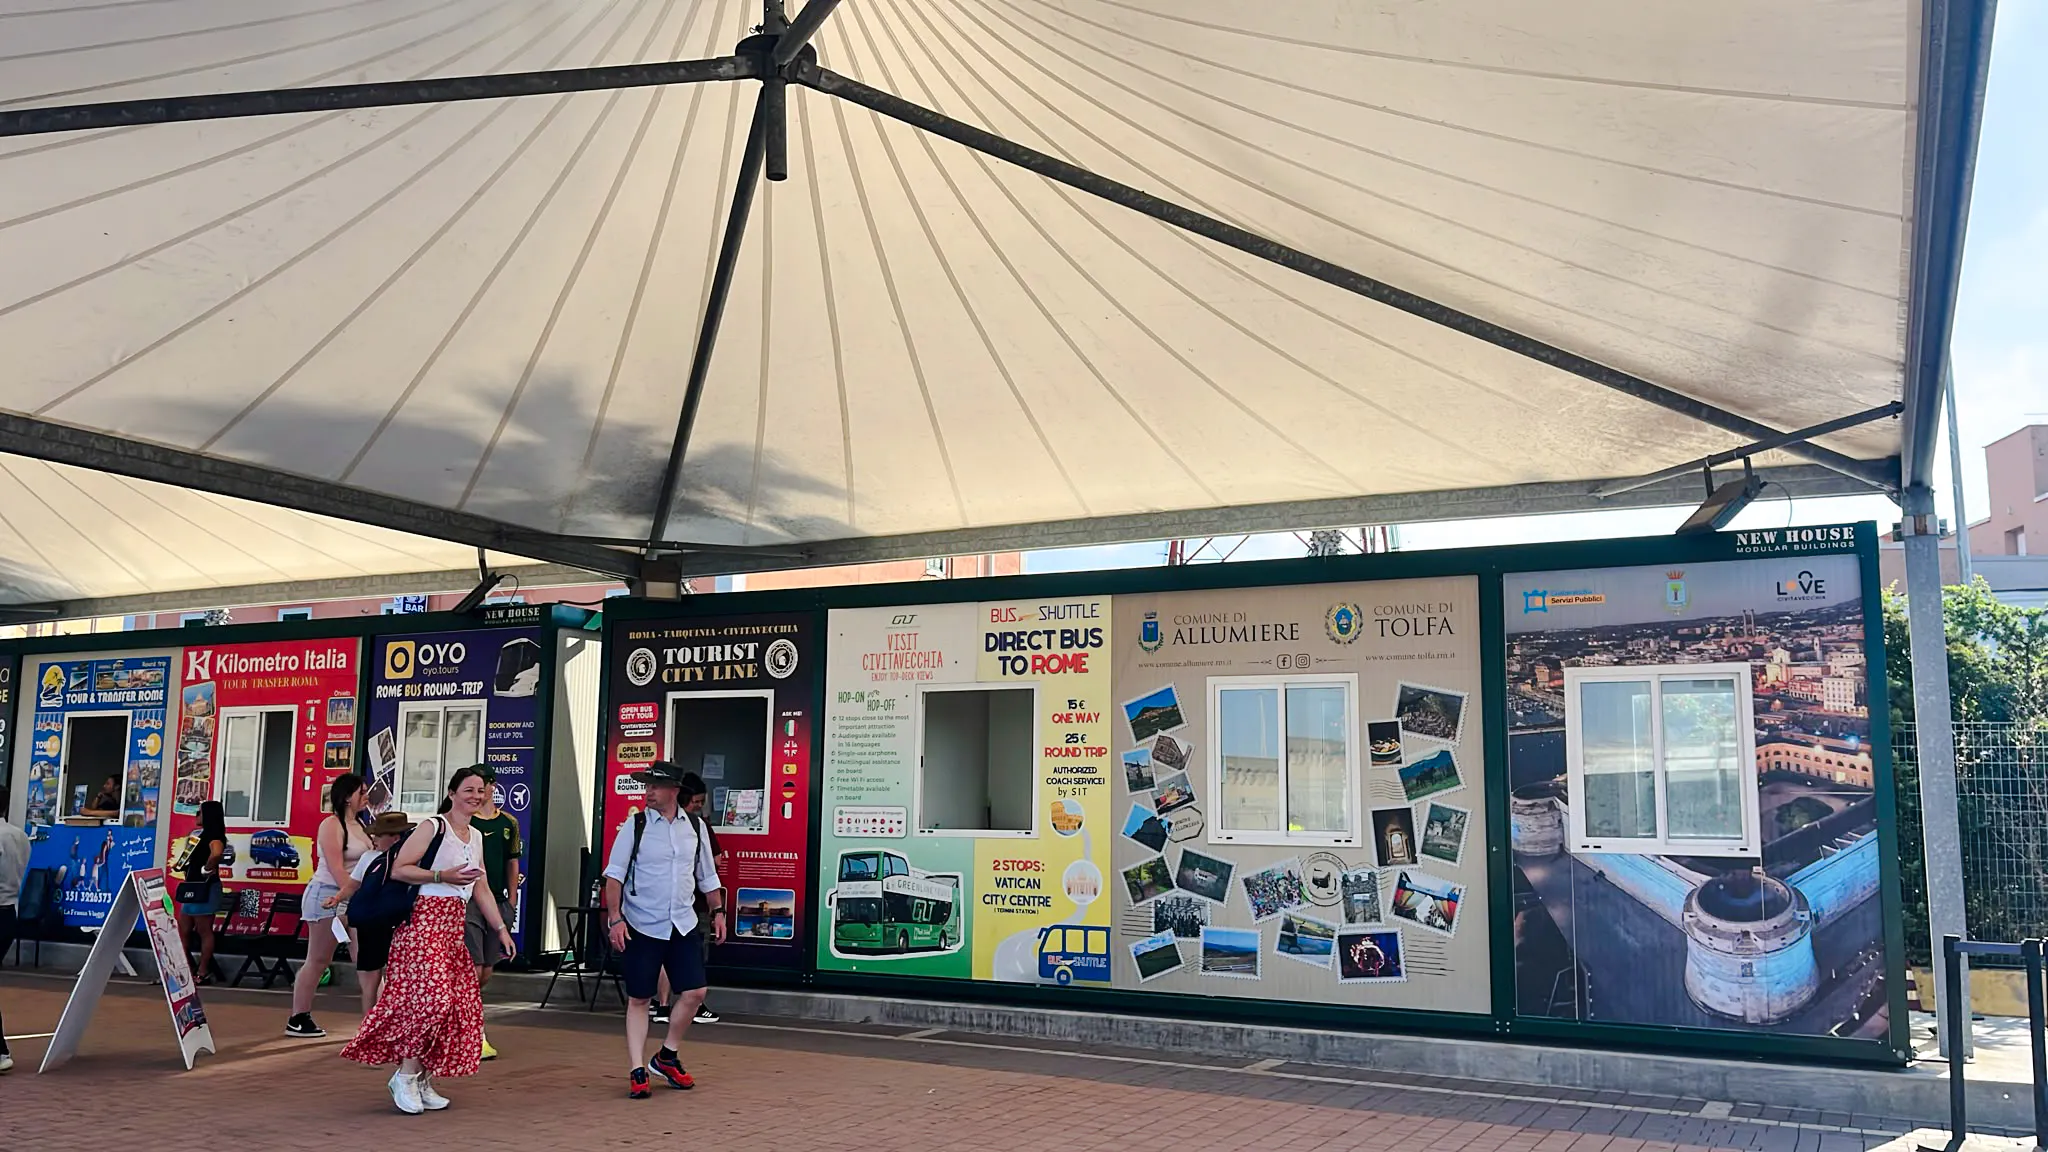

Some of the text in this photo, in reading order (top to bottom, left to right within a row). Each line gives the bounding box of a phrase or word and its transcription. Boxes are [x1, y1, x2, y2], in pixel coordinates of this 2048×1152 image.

[1736, 526, 1855, 546] NEW HOUSE
[1736, 541, 1855, 553] MODULAR BUILDINGS
[1574, 595, 1603, 603] Pubblici
[405, 603, 424, 613] BAR
[485, 607, 540, 620] NEW HOUSE
[990, 603, 1100, 623] BUS SHUTTLE
[1374, 602, 1454, 616] COMUNE DI
[1173, 612, 1247, 626] COMUNE DI
[629, 624, 798, 640] ROMA TARQUINIA CIVITAVECCHIA
[1374, 616, 1455, 638] TOLFA
[985, 627, 1103, 652] DIRECT BUS
[1172, 623, 1299, 646] ALLUMIERE
[887, 633, 919, 650] VISIT
[418, 642, 466, 666] OYO
[663, 642, 759, 665] TOURIST
[1365, 651, 1456, 661] www.comune.tolfa.rm.it
[216, 649, 347, 674] Kilometro Italia
[862, 651, 943, 671] CIVITAVECCHIA
[998, 653, 1089, 676] TO ROME
[423, 666, 460, 677] oyo.tours
[661, 663, 758, 684] CITY LINE
[222, 676, 319, 690] TOUR TRASFER ROMA
[376, 681, 484, 699] ROME BUS ROUND-TRIP
[66, 690, 164, 704] TOUR & TRANSFER ROME
[838, 691, 865, 704] HOP-ON
[867, 698, 896, 711] HOP-OFF
[1051, 712, 1100, 724] ONE WAY
[487, 754, 511, 762] TOURS
[1044, 746, 1108, 758] ROUND TRIP
[492, 766, 524, 775] ANSFERS
[1053, 766, 1098, 774] AUTHORIZED
[1046, 777, 1073, 785] COACH
[1058, 787, 1067, 798] by
[736, 851, 798, 860] CIVITAVECCHIA
[992, 860, 1045, 872] 2 STOPS:
[995, 877, 1041, 889] VATICAN
[65, 891, 78, 902] 351
[982, 893, 1052, 907] CITY CENTRE
[1047, 955, 1107, 968] BUS SHUTTLE
